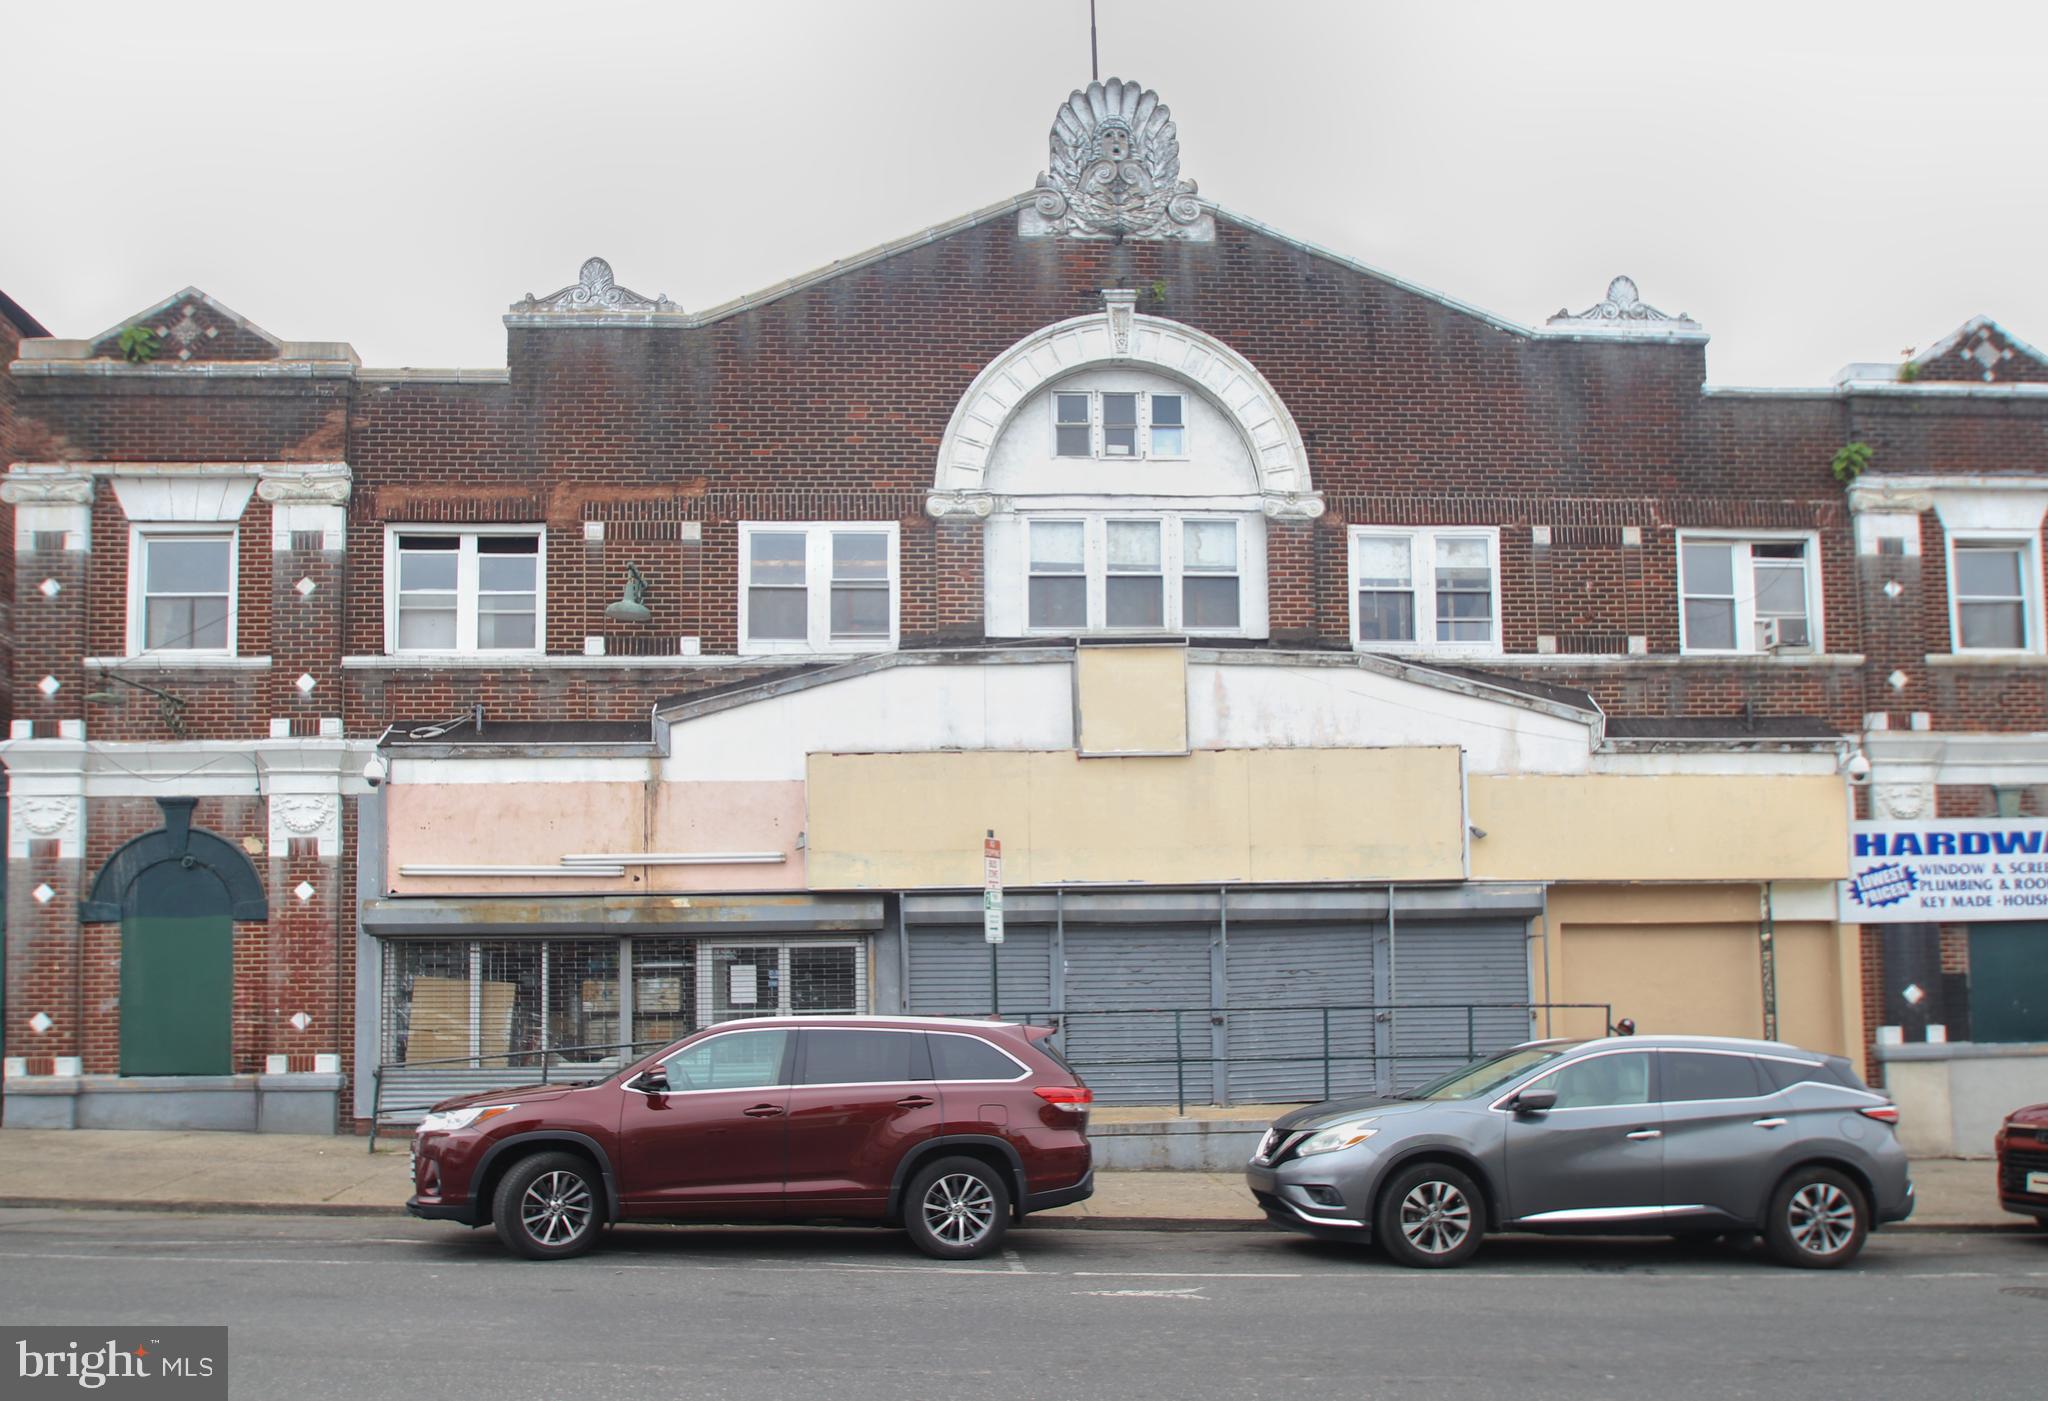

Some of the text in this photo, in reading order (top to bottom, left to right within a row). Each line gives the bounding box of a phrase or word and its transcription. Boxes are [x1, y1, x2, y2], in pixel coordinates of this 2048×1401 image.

[1919, 863, 1985, 875] WINDOW
[1992, 863, 2003, 874] &
[1920, 877, 2048, 891] PLUMBING & ROO
[1920, 896, 1946, 908] KEY
[1951, 895, 1992, 907] MADE
